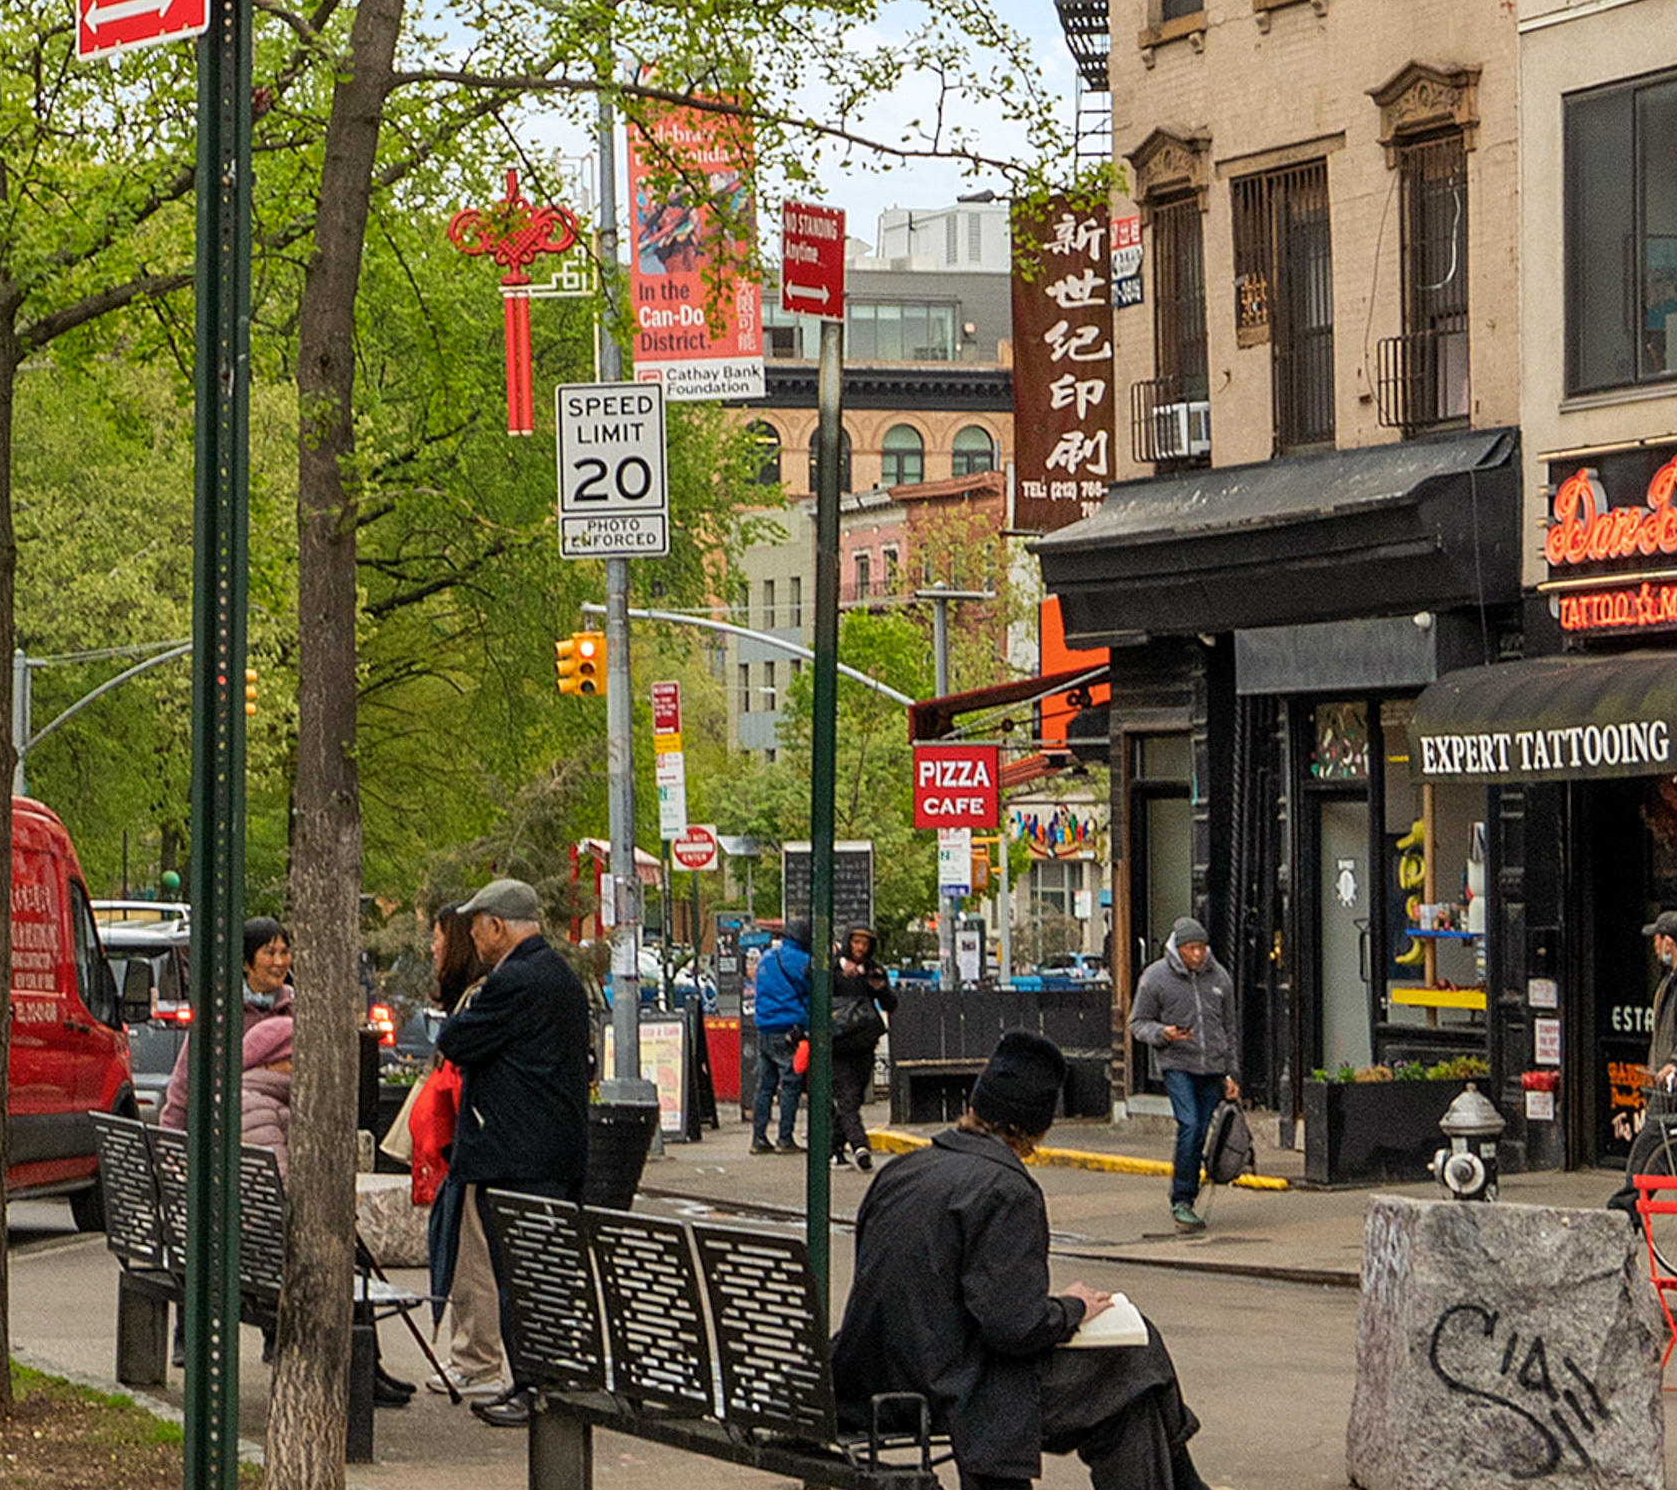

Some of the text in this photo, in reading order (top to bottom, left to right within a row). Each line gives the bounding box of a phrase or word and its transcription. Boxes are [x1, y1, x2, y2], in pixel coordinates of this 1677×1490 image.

[785, 211, 838, 241] NO STANDING
[786, 238, 819, 265] Anytime
[639, 280, 689, 301] In the
[639, 305, 704, 328] Can-Do
[641, 331, 712, 352] District.
[666, 364, 761, 381] Cathay Bank
[667, 381, 749, 396] Foundation
[568, 395, 654, 417] SPEED
[578, 423, 644, 444] LIMIT
[573, 456, 652, 502] 20
[587, 519, 640, 532] PHOTO
[1546, 469, 1641, 566] Dare
[572, 532, 656, 548] ENFORCED
[1559, 590, 1632, 630] TATTOO
[1420, 720, 1670, 774] EXPERT TATTOOING
[919, 761, 991, 788] PIZZA
[923, 797, 984, 815] CAFE
